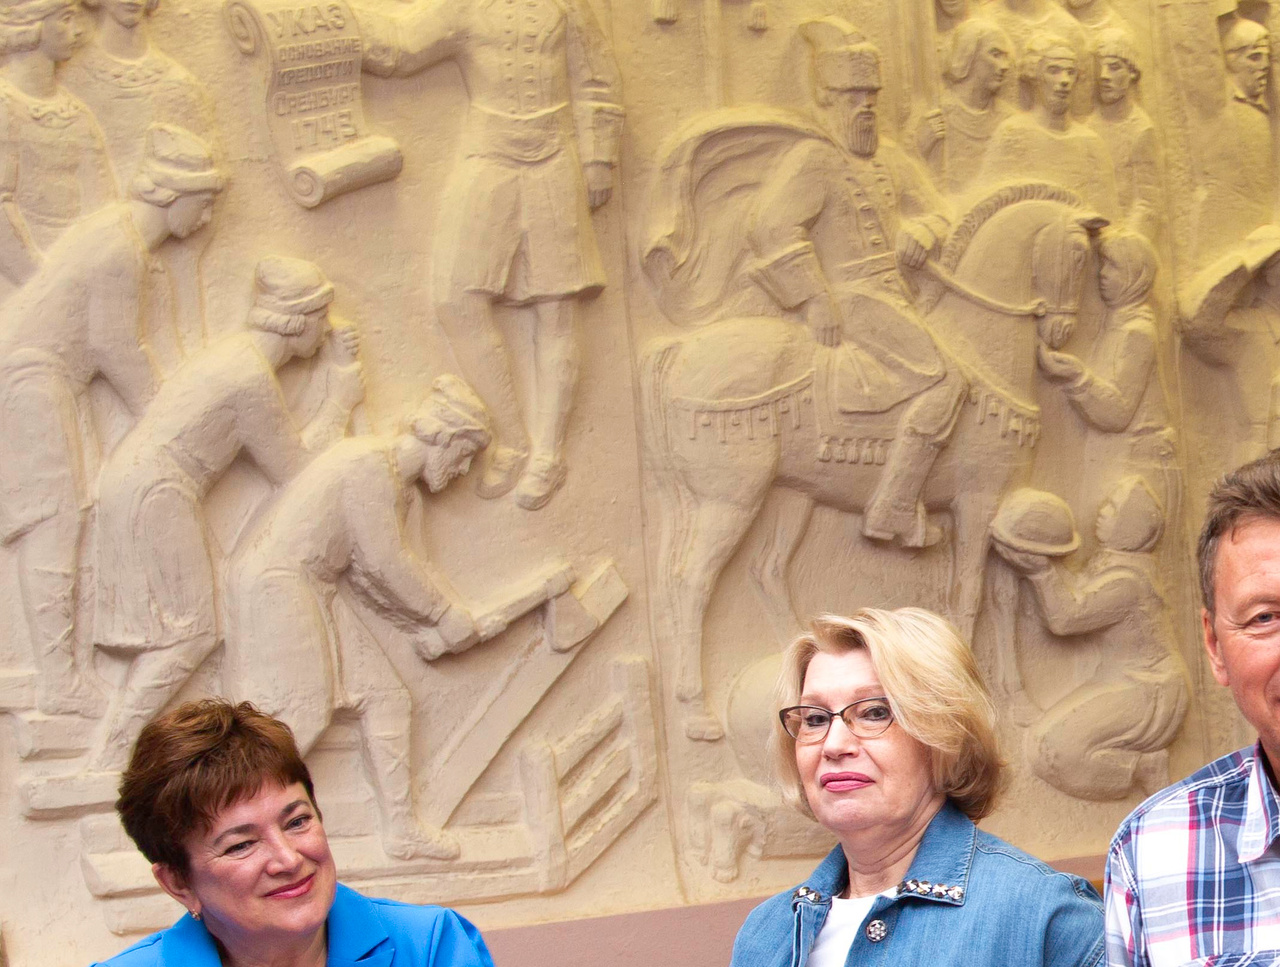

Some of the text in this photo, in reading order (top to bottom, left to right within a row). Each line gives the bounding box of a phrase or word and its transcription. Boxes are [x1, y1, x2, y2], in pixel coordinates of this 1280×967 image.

[266, 3, 345, 38] УКАЗ
[278, 37, 361, 62] ОСНОВАНИЕ
[276, 59, 354, 86] КРЕПОСТИ
